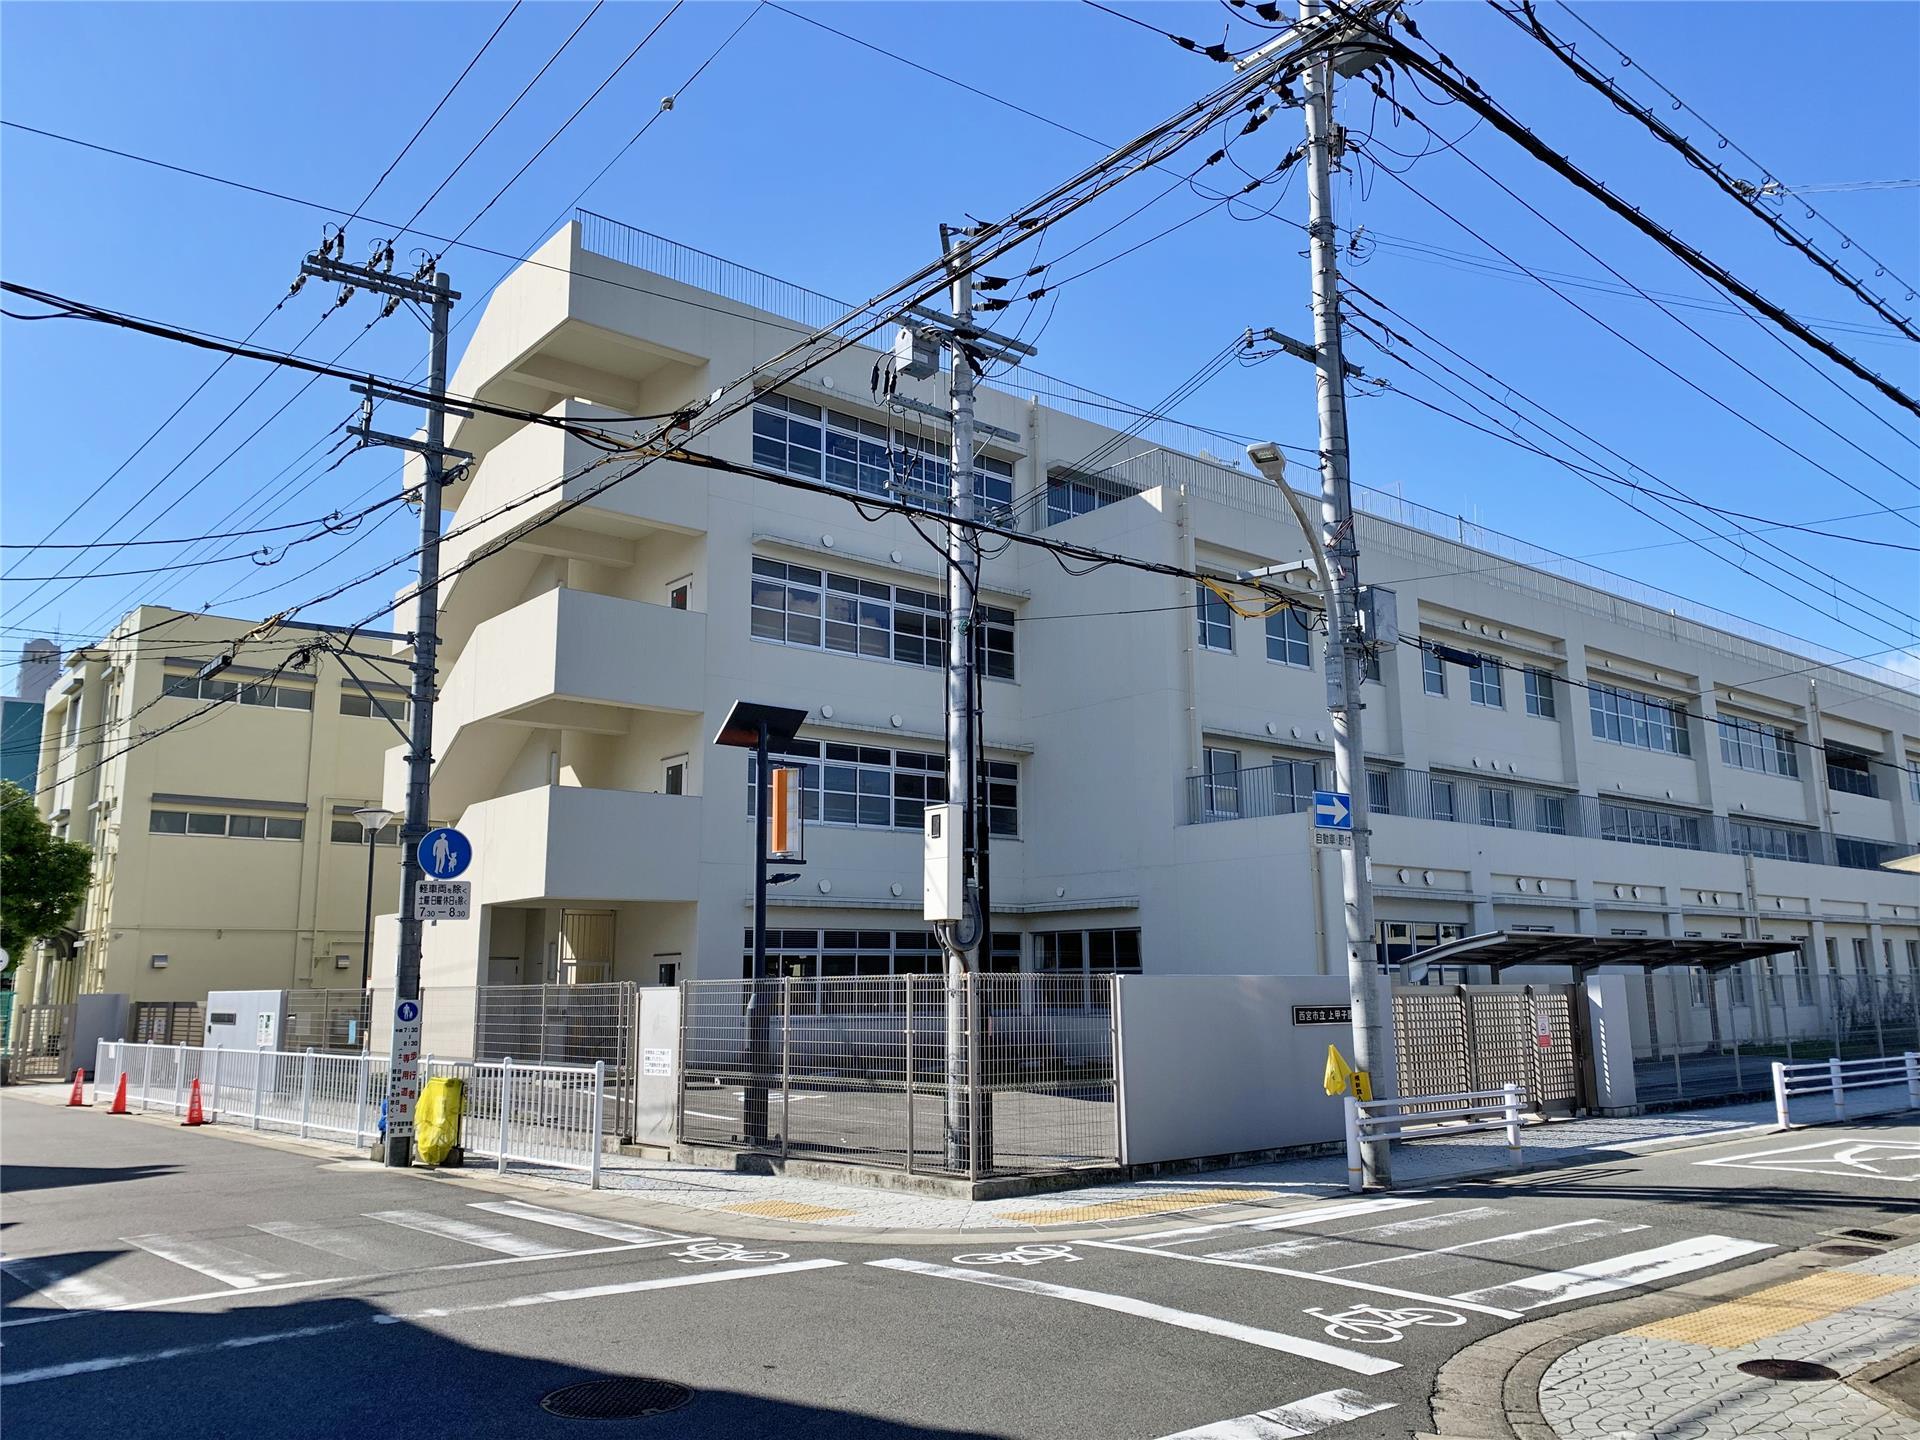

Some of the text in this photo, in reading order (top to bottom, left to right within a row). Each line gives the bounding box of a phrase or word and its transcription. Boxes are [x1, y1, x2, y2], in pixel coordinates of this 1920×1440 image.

[419, 884, 467, 894] 軽車両を除く
[1298, 1010, 1326, 1021] 西宮市立
